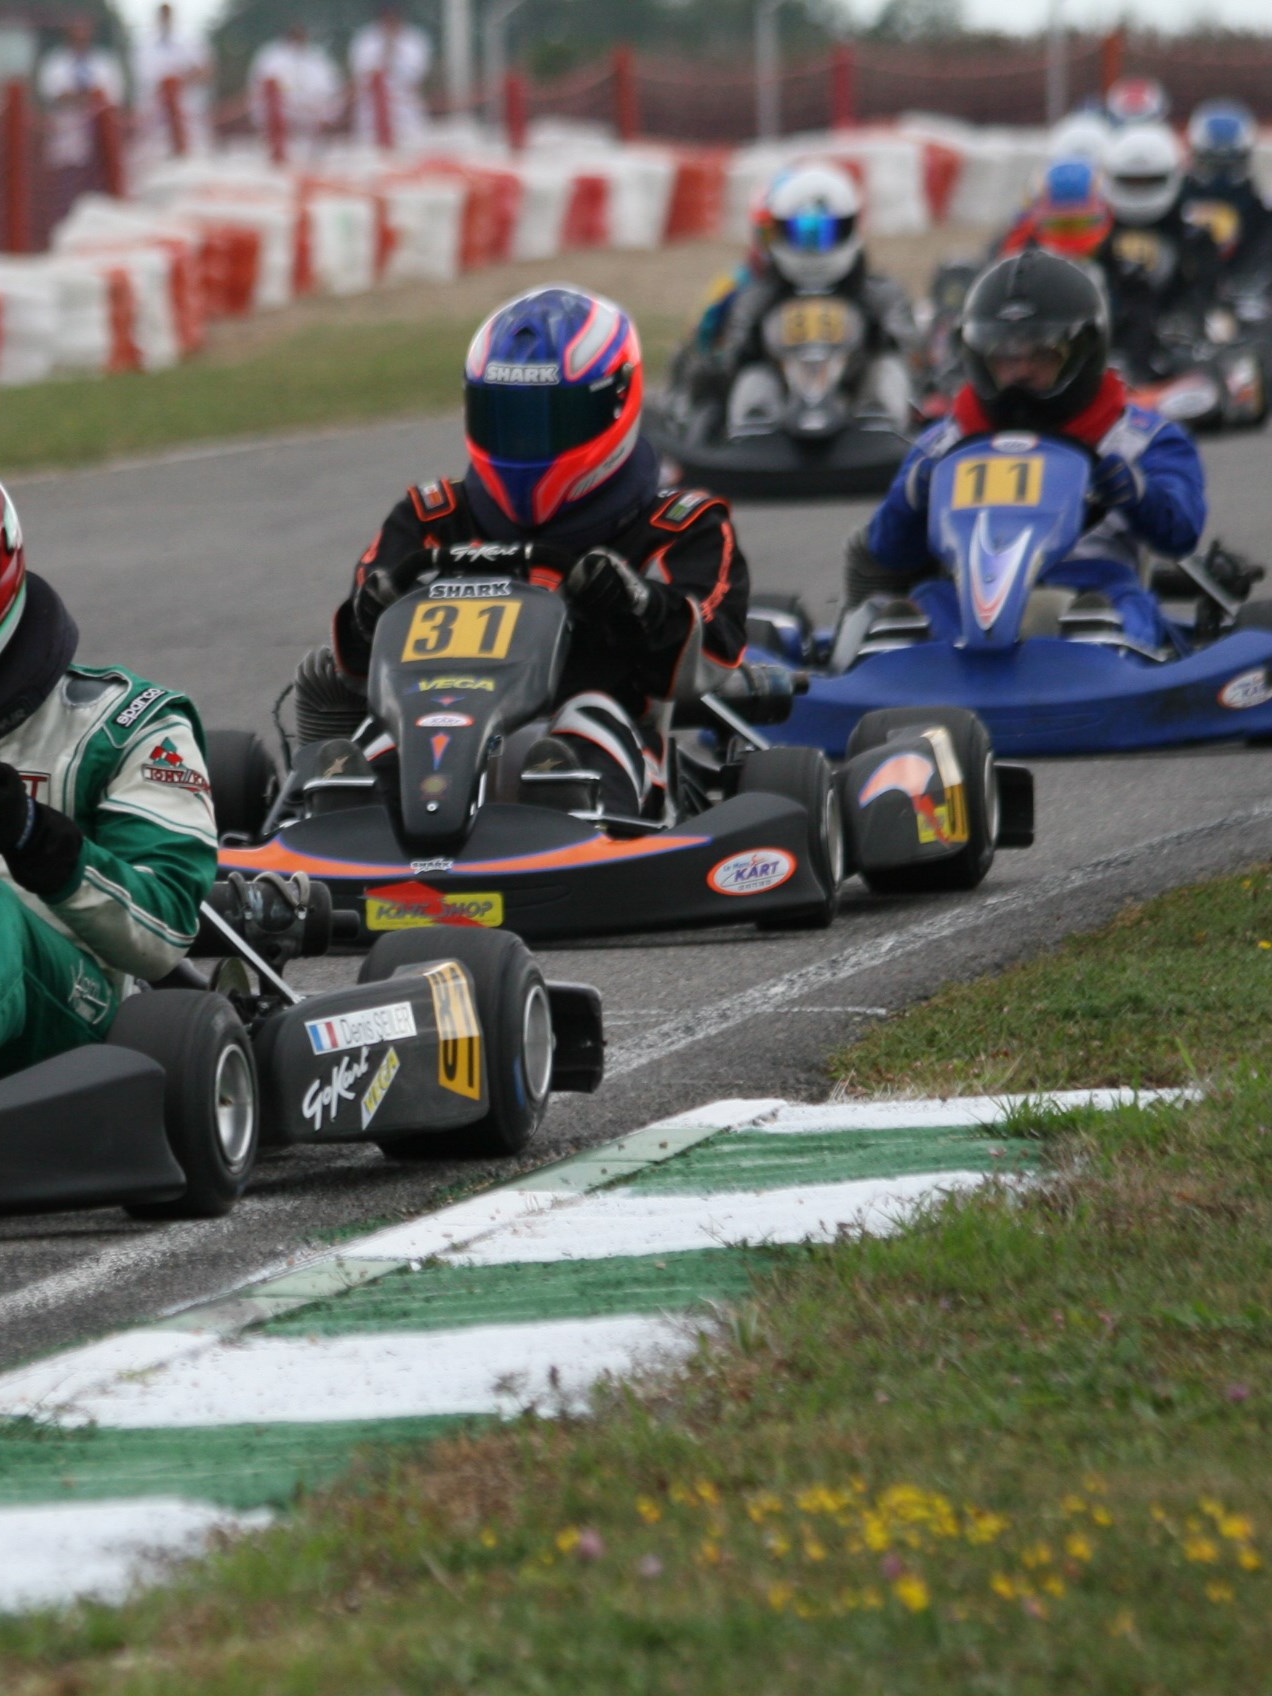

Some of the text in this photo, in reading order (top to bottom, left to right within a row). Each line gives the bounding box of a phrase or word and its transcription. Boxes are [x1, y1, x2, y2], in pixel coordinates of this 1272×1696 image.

[486, 365, 557, 384] SHARK
[966, 460, 1031, 505] 11
[429, 582, 511, 599] SHARK
[412, 604, 506, 657] 31
[418, 676, 496, 693] VEGA
[116, 687, 166, 727] sparco
[734, 861, 780, 882] KART
[340, 1015, 378, 1045] Denis
